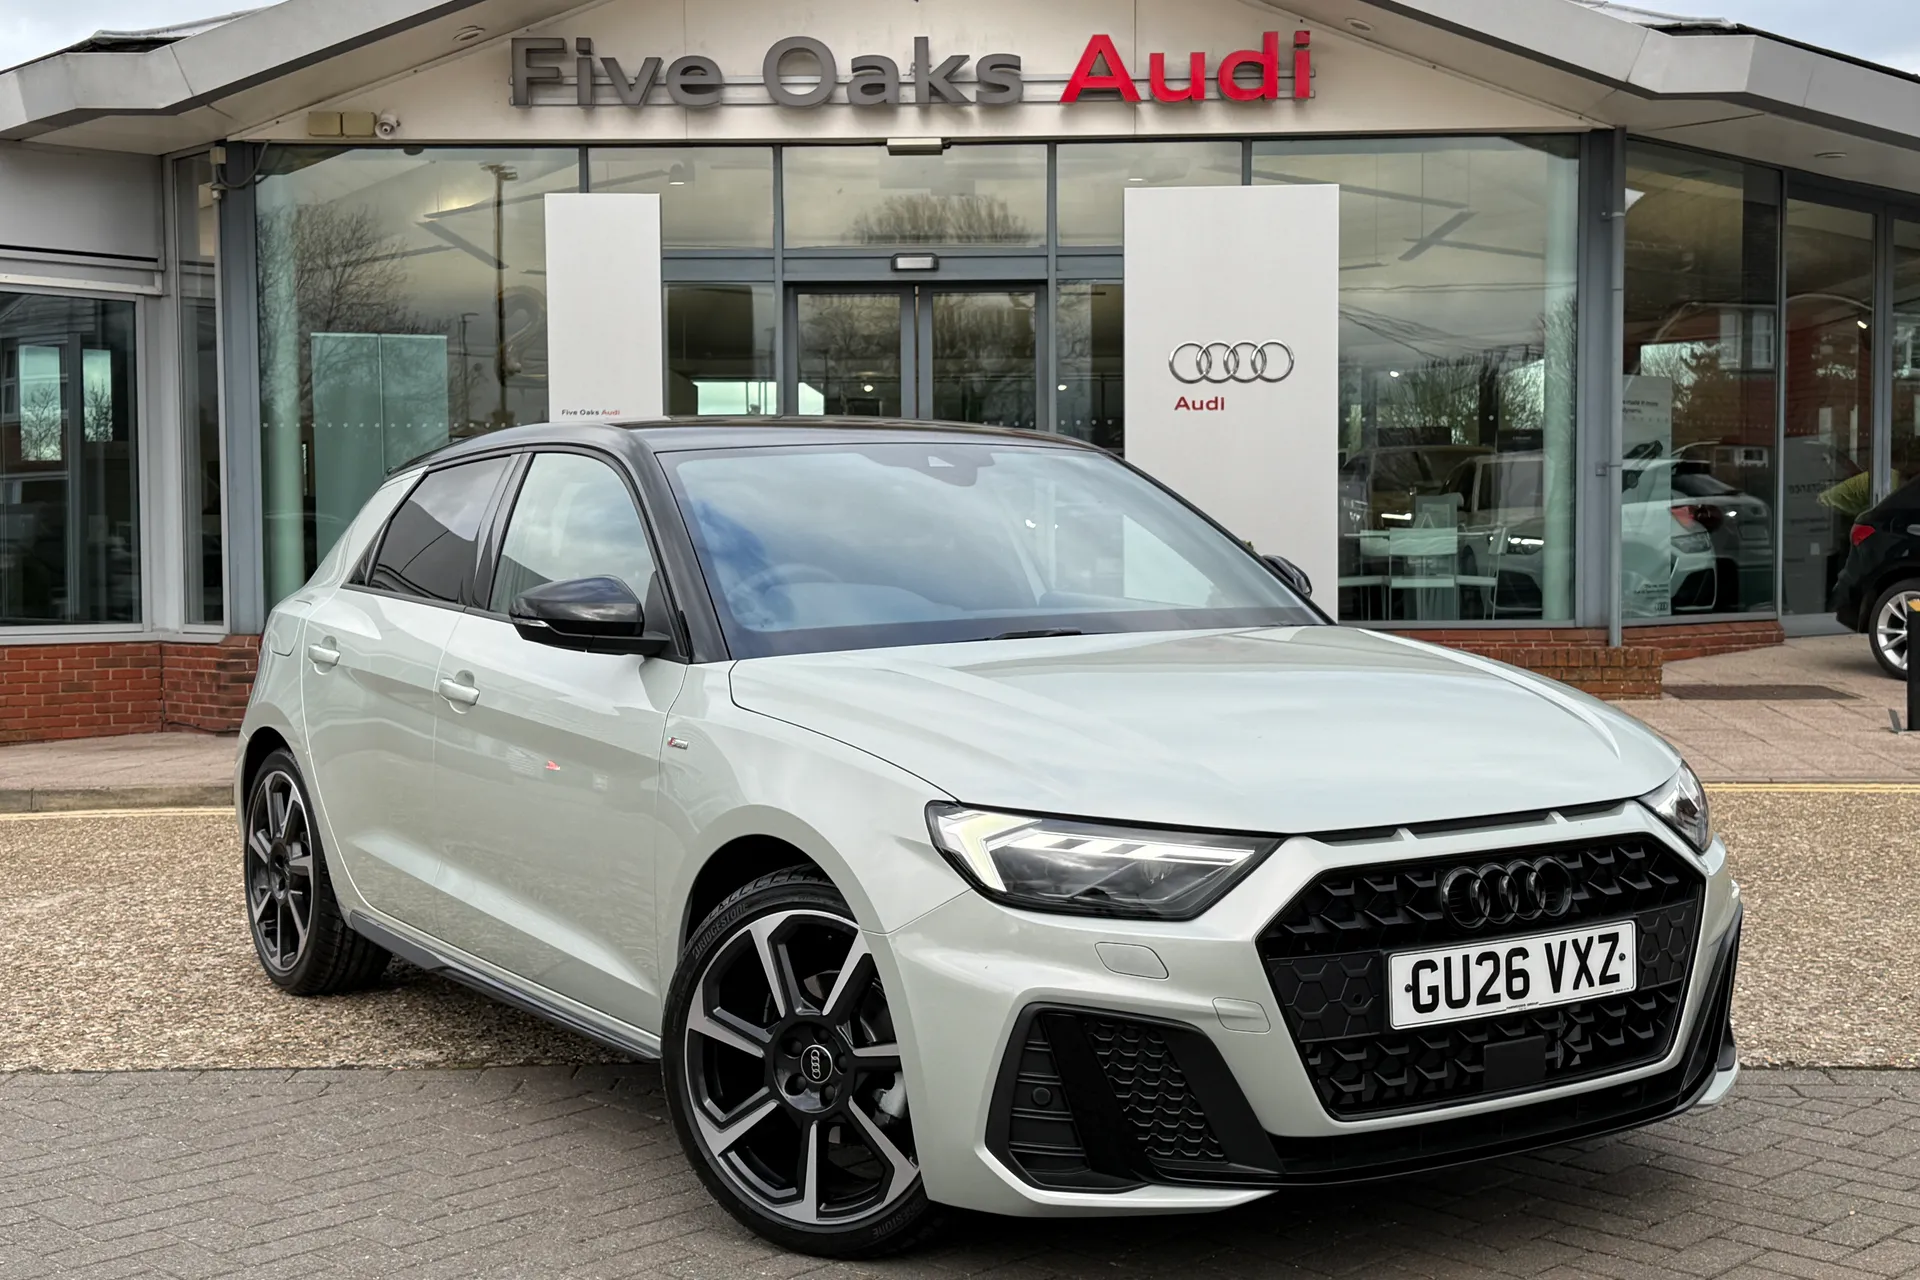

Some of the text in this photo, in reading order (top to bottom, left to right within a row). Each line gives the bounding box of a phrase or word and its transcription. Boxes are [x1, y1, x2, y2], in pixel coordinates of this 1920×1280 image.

[511, 31, 1311, 108] Five Oaks Audi
[1174, 396, 1225, 411] Audi
[691, 902, 749, 960] BRIDGESTONE
[1411, 932, 1620, 1014] GU26 VXZ
